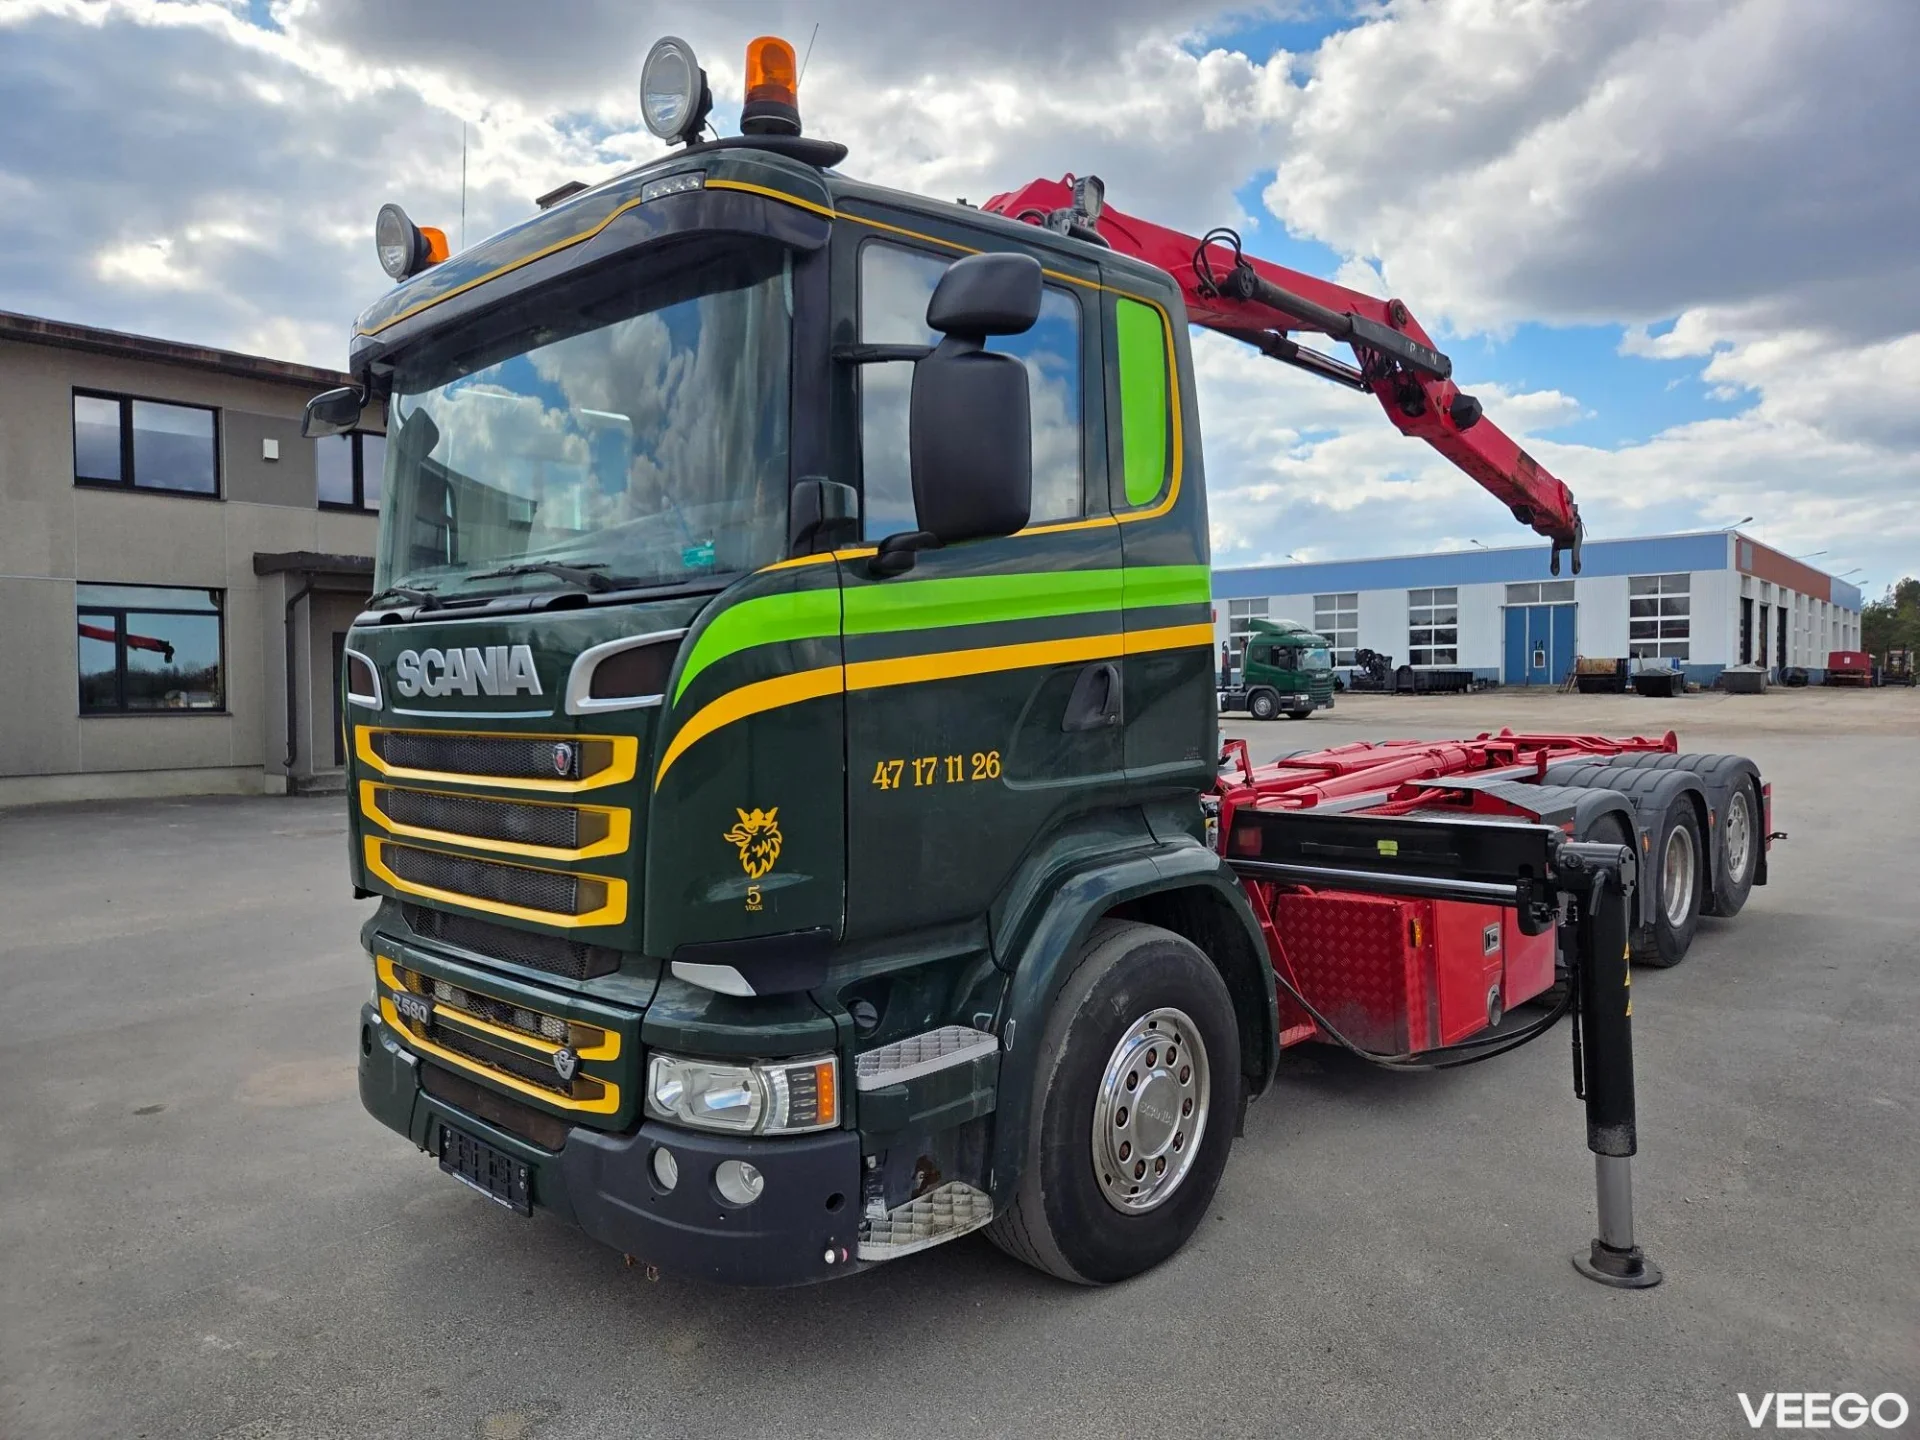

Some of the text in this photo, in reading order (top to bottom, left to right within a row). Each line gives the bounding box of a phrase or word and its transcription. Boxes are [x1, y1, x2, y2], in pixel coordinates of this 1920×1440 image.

[396, 644, 544, 697] SCANIA
[872, 750, 1000, 790] 47 17 11 26
[746, 884, 761, 905] 5
